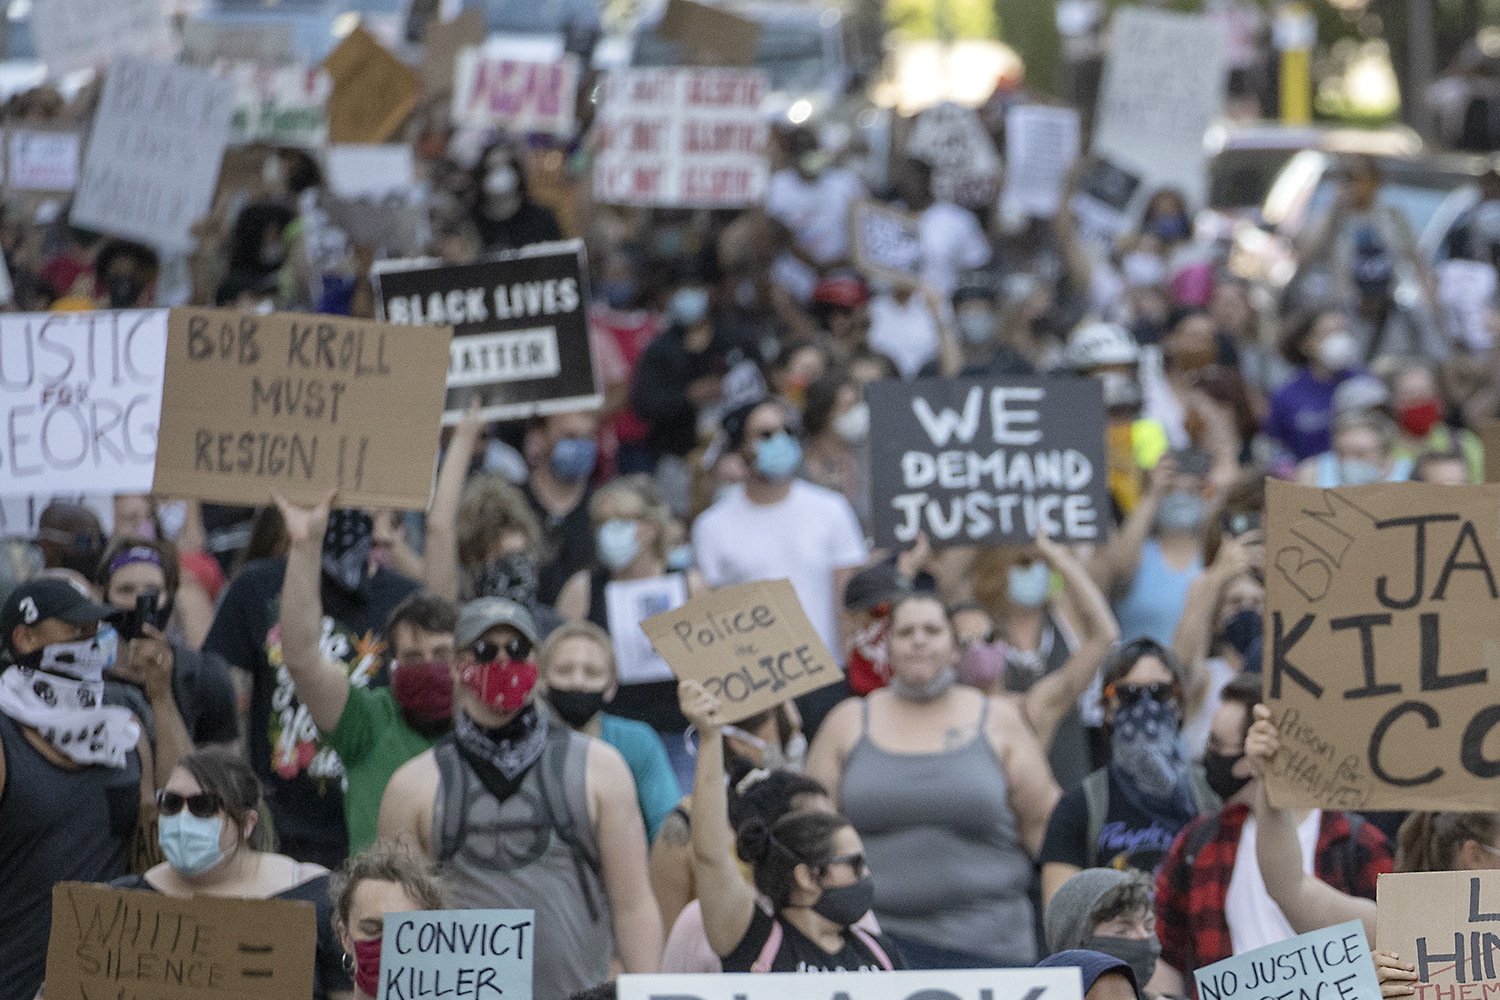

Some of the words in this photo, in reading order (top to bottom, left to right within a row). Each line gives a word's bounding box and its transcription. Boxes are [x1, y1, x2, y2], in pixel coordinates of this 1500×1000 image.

[387, 286, 489, 327] BLACK
[494, 277, 580, 320] LIVES
[0, 311, 159, 392] USTIC
[187, 315, 260, 365] BOB
[287, 322, 391, 377] KROLL
[451, 338, 546, 373] ATTER
[251, 377, 346, 424] MUST
[910, 385, 1046, 447] WE
[0, 393, 157, 477] EORG
[195, 428, 318, 479] RESIGN
[901, 449, 1094, 492] DEMAND
[891, 490, 1099, 542] JUSTICE
[1274, 486, 1381, 602] BLM
[672, 604, 777, 654] Police
[702, 644, 825, 703] POLICE
[69, 887, 216, 956] WHITE
[396, 920, 532, 960] CONVICT
[76, 937, 225, 990] SILENCE
[1245, 933, 1363, 990] JUSTICE
